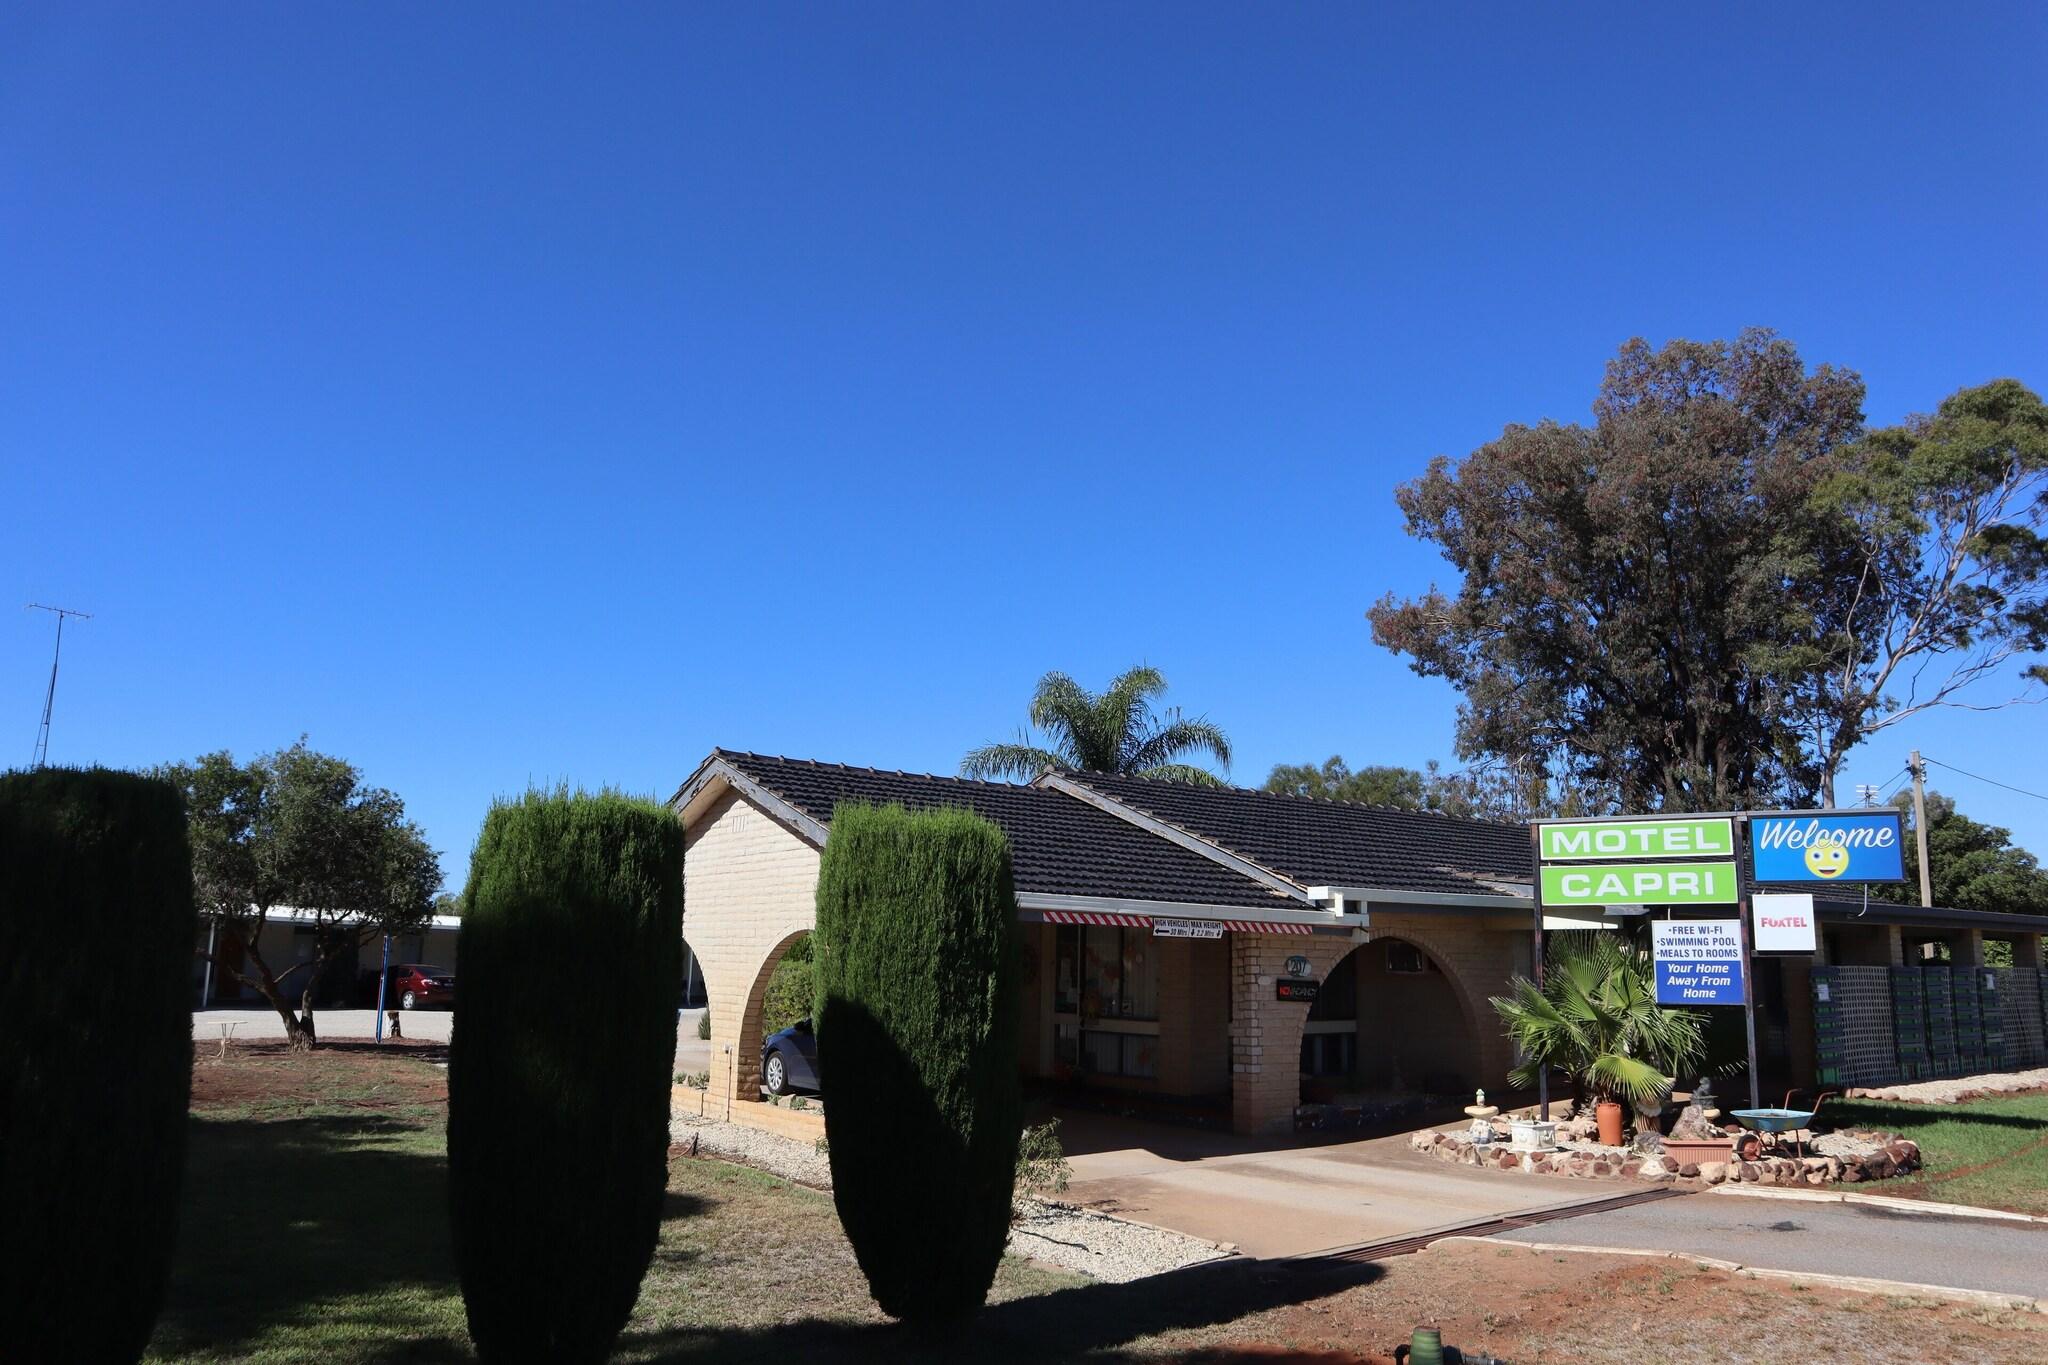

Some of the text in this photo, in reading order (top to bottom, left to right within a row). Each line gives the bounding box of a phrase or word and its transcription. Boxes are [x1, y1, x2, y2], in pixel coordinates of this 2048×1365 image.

[1760, 819, 1895, 850] Welcome
[1552, 826, 1720, 854] MOTEL
[1561, 871, 1714, 898] CAPRI
[1203, 922, 1221, 930] HEIGHT
[1672, 925, 1723, 935] FREE WI-FI
[1660, 937, 1737, 947] SWIMMING POOL
[1660, 949, 1738, 958] MEALS TO ROOMS
[1667, 963, 1729, 974] Your Home
[1667, 976, 1731, 987] Away From
[1683, 988, 1717, 998] Home
